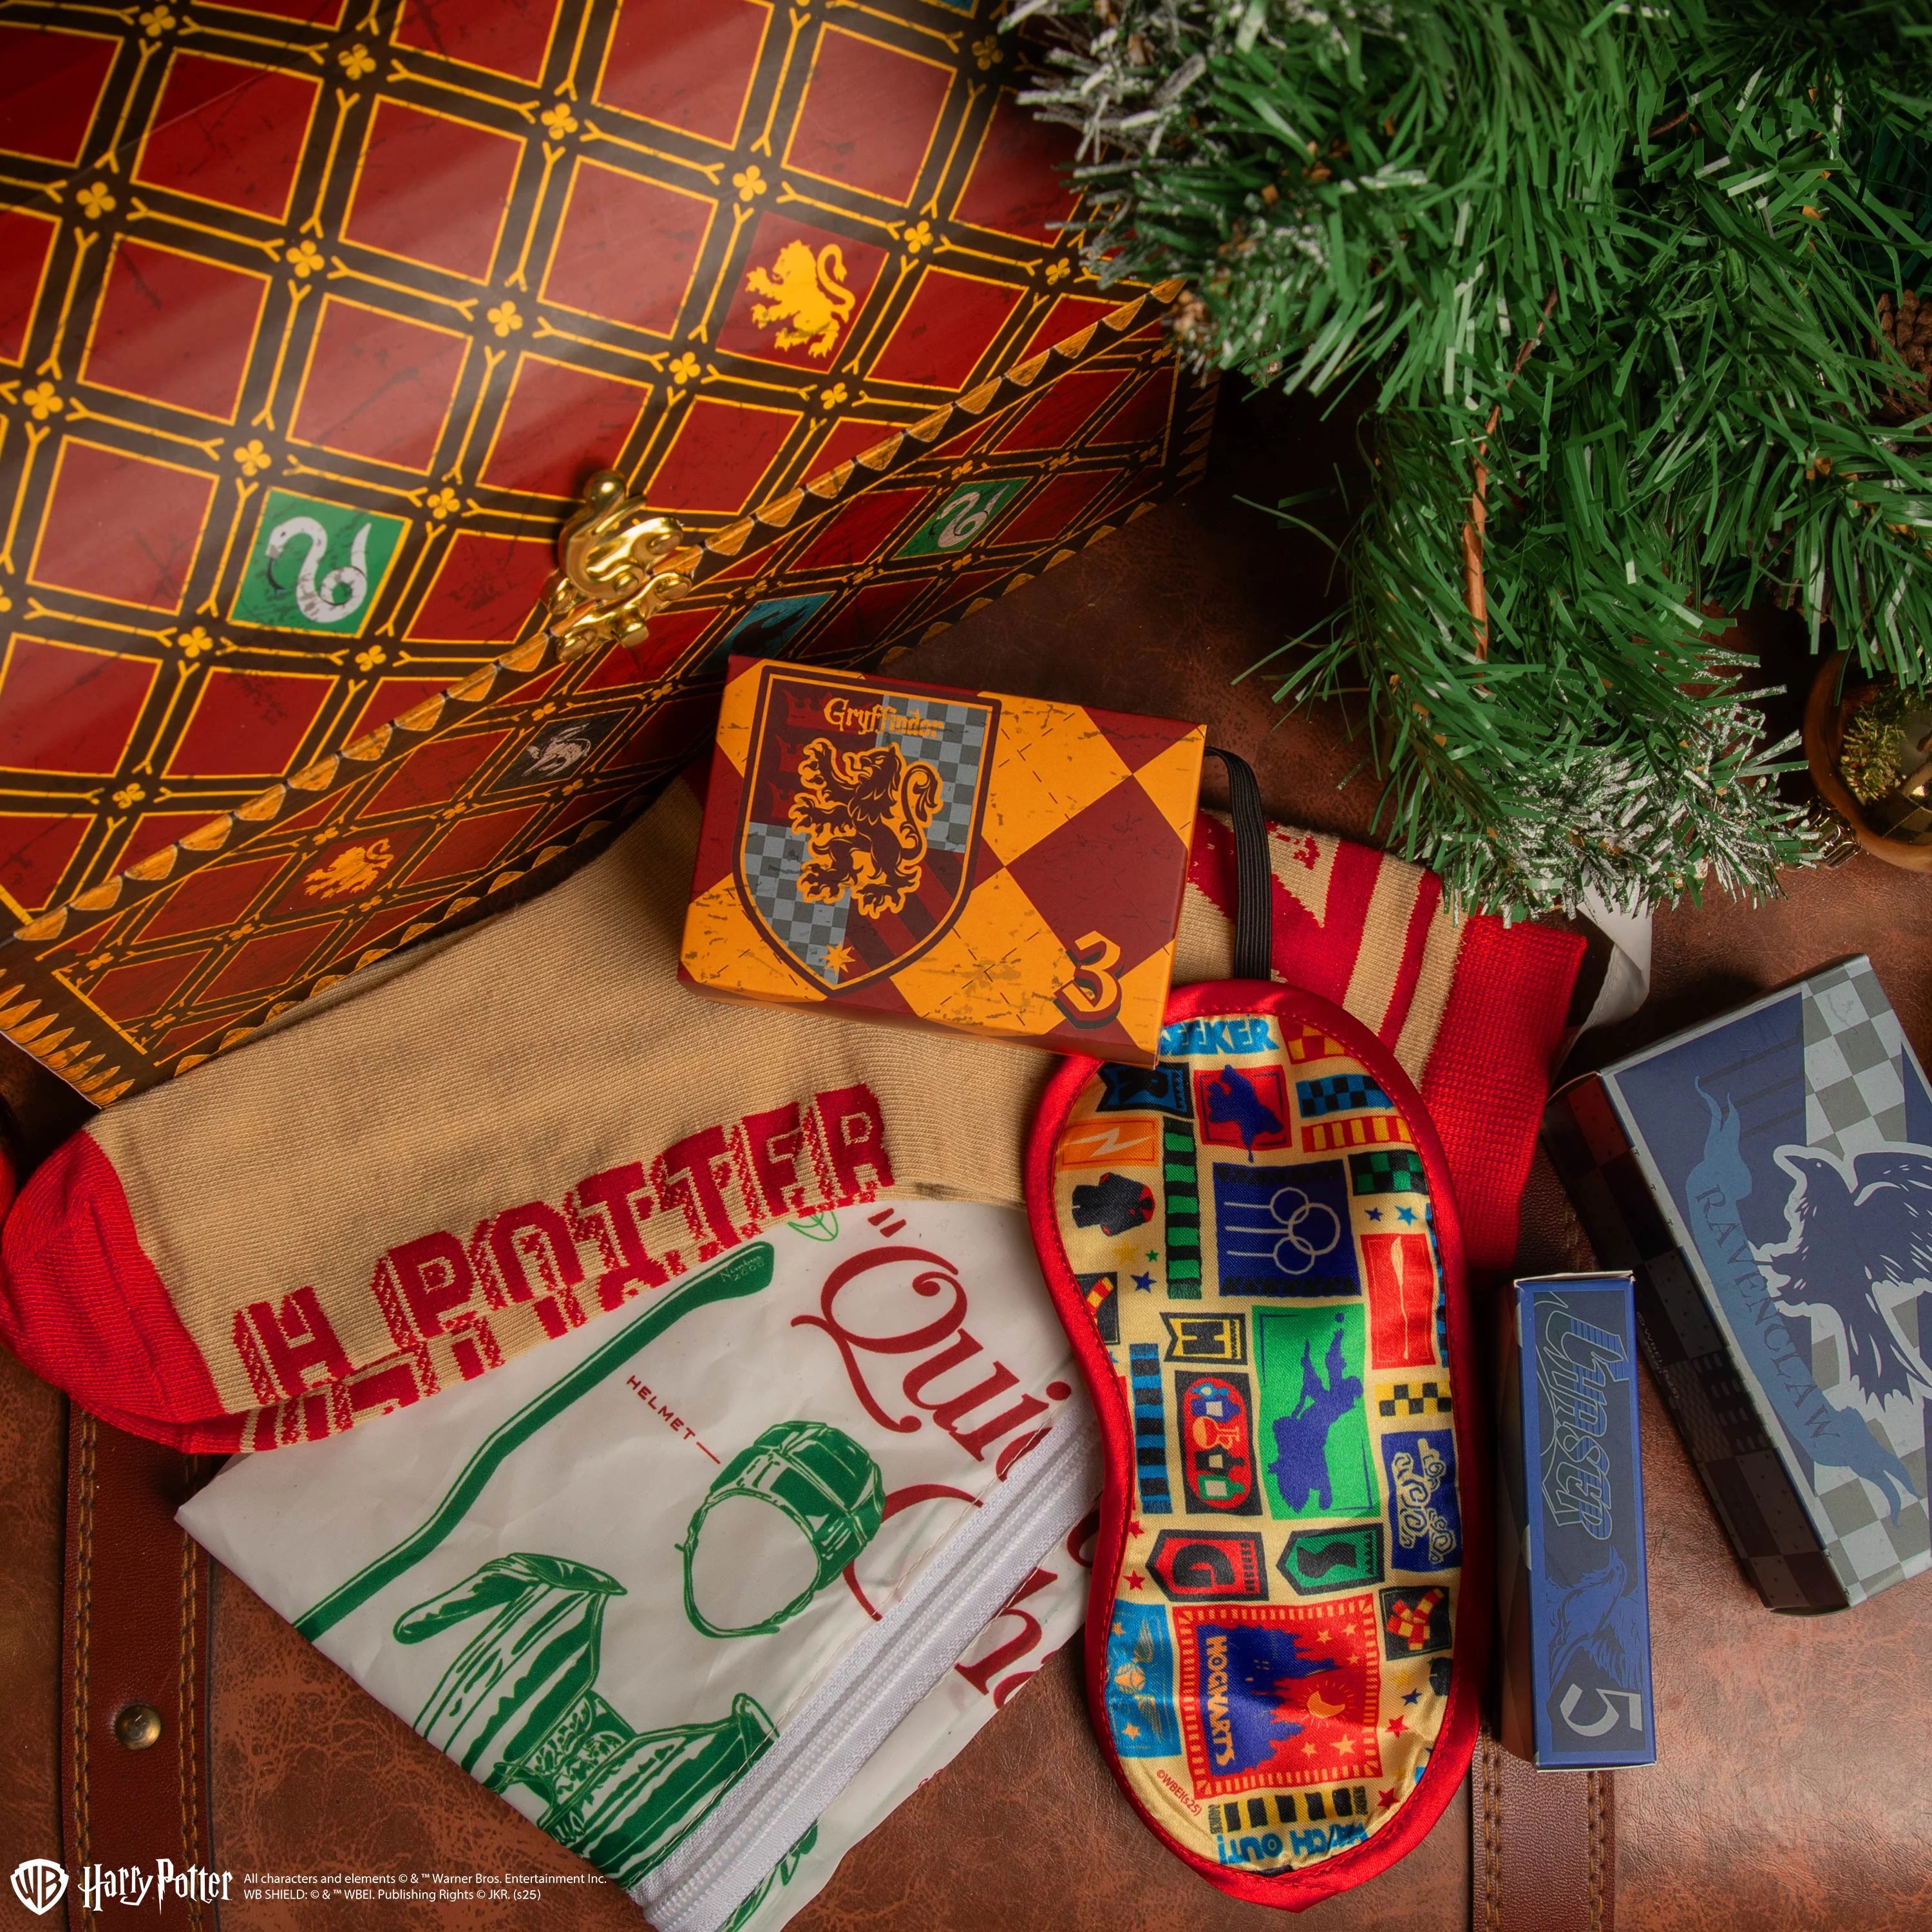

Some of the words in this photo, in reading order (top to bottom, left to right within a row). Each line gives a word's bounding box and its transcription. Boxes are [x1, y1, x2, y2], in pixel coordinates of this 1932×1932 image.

[824, 697, 945, 738] Gryffindor
[1053, 931, 1126, 1030] 3
[1696, 1183, 1841, 1439] RAVENCLAW
[625, 1374, 696, 1442] HELMET
[1206, 1635, 1235, 1766] HOGWARTS
[1558, 1683, 1642, 1738] 5
